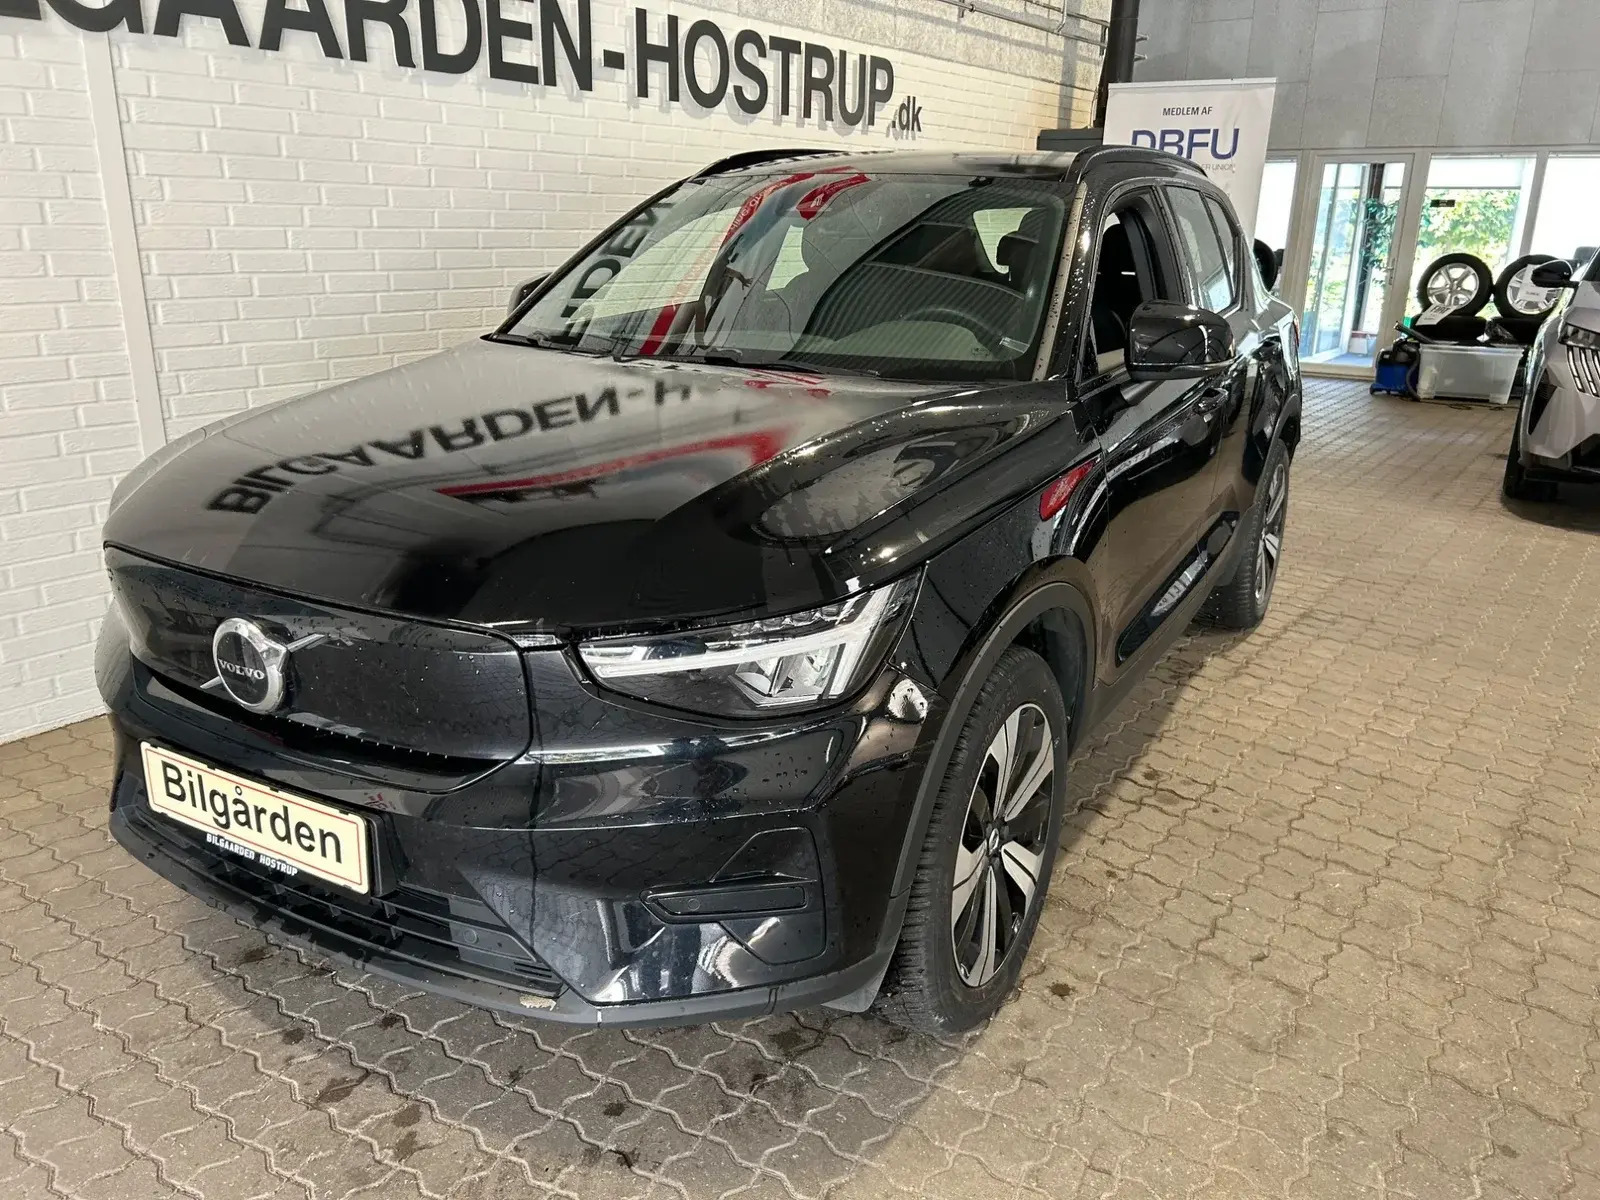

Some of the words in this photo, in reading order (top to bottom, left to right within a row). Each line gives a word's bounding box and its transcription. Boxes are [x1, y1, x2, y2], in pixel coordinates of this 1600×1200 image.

[1162, 106, 1200, 116] MEDLEM
[1201, 106, 1213, 115] AF
[218, 658, 265, 680] VOLVO
[161, 760, 342, 864] Bilgården
[206, 833, 255, 860] BILGAARDEN
[259, 854, 298, 877] HOSTRUP
